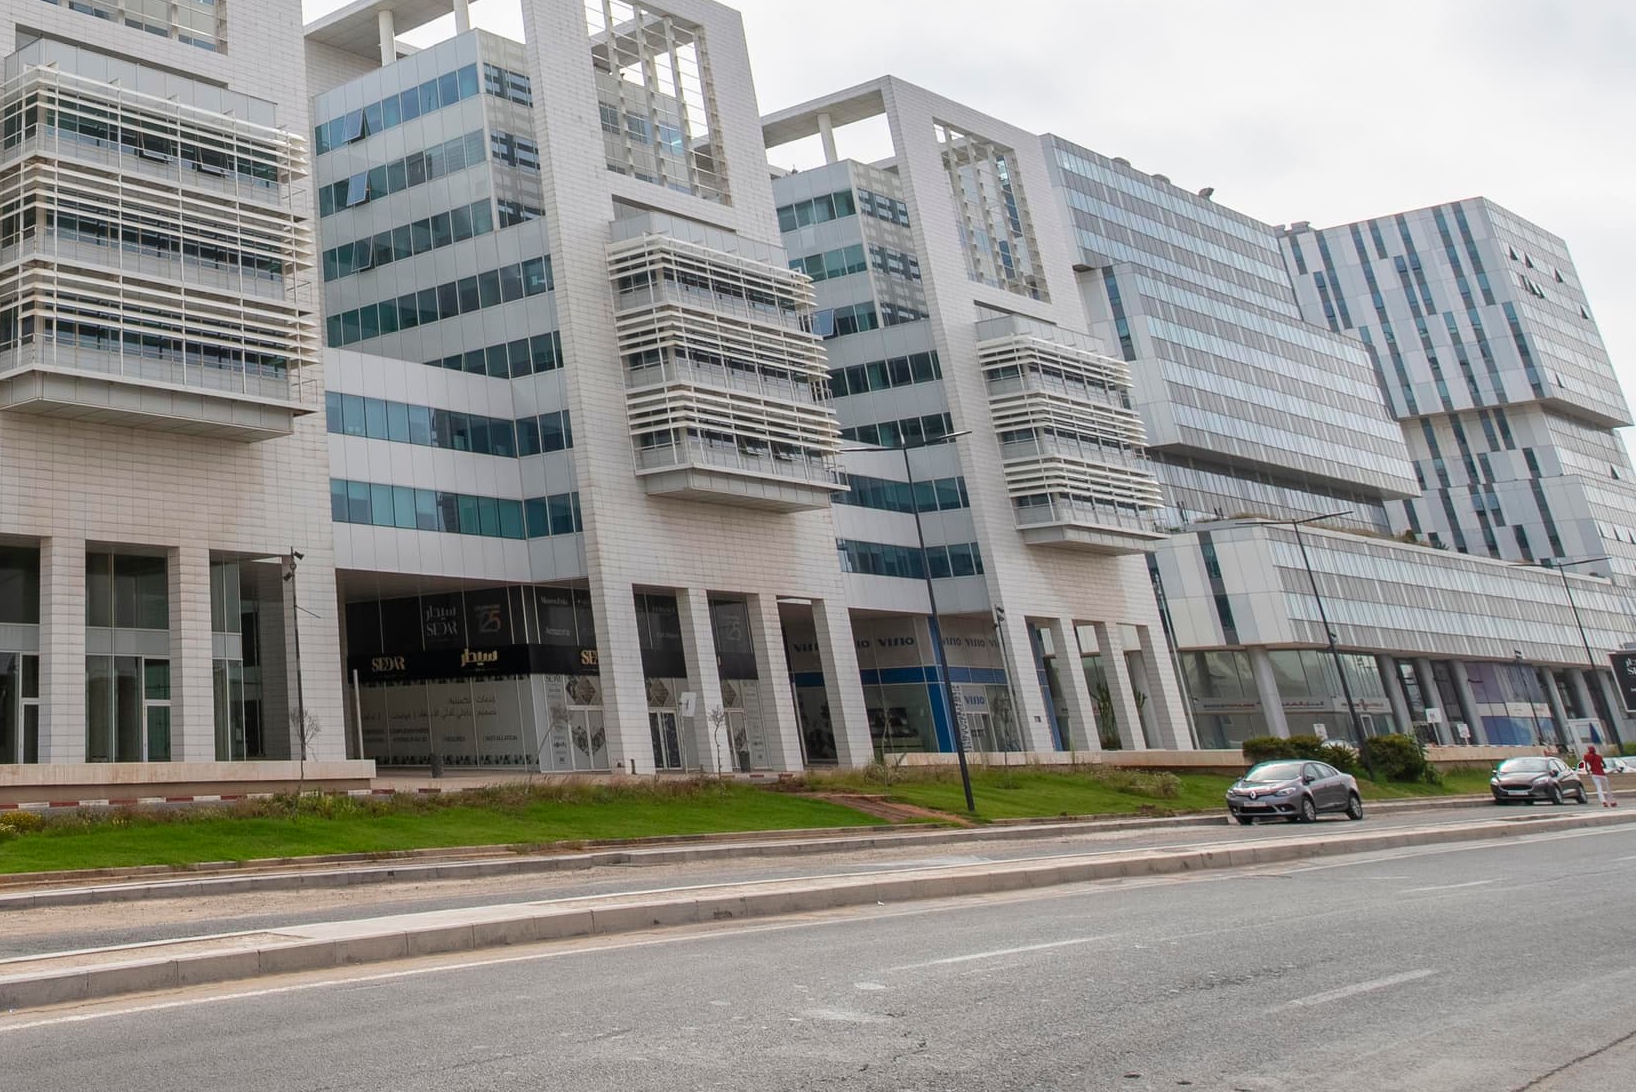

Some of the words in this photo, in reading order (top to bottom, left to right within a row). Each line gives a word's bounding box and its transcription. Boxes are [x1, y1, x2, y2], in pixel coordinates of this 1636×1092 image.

[372, 656, 405, 672] SEDAR
[460, 650, 498, 668] سيدار
[580, 649, 599, 665] SE
